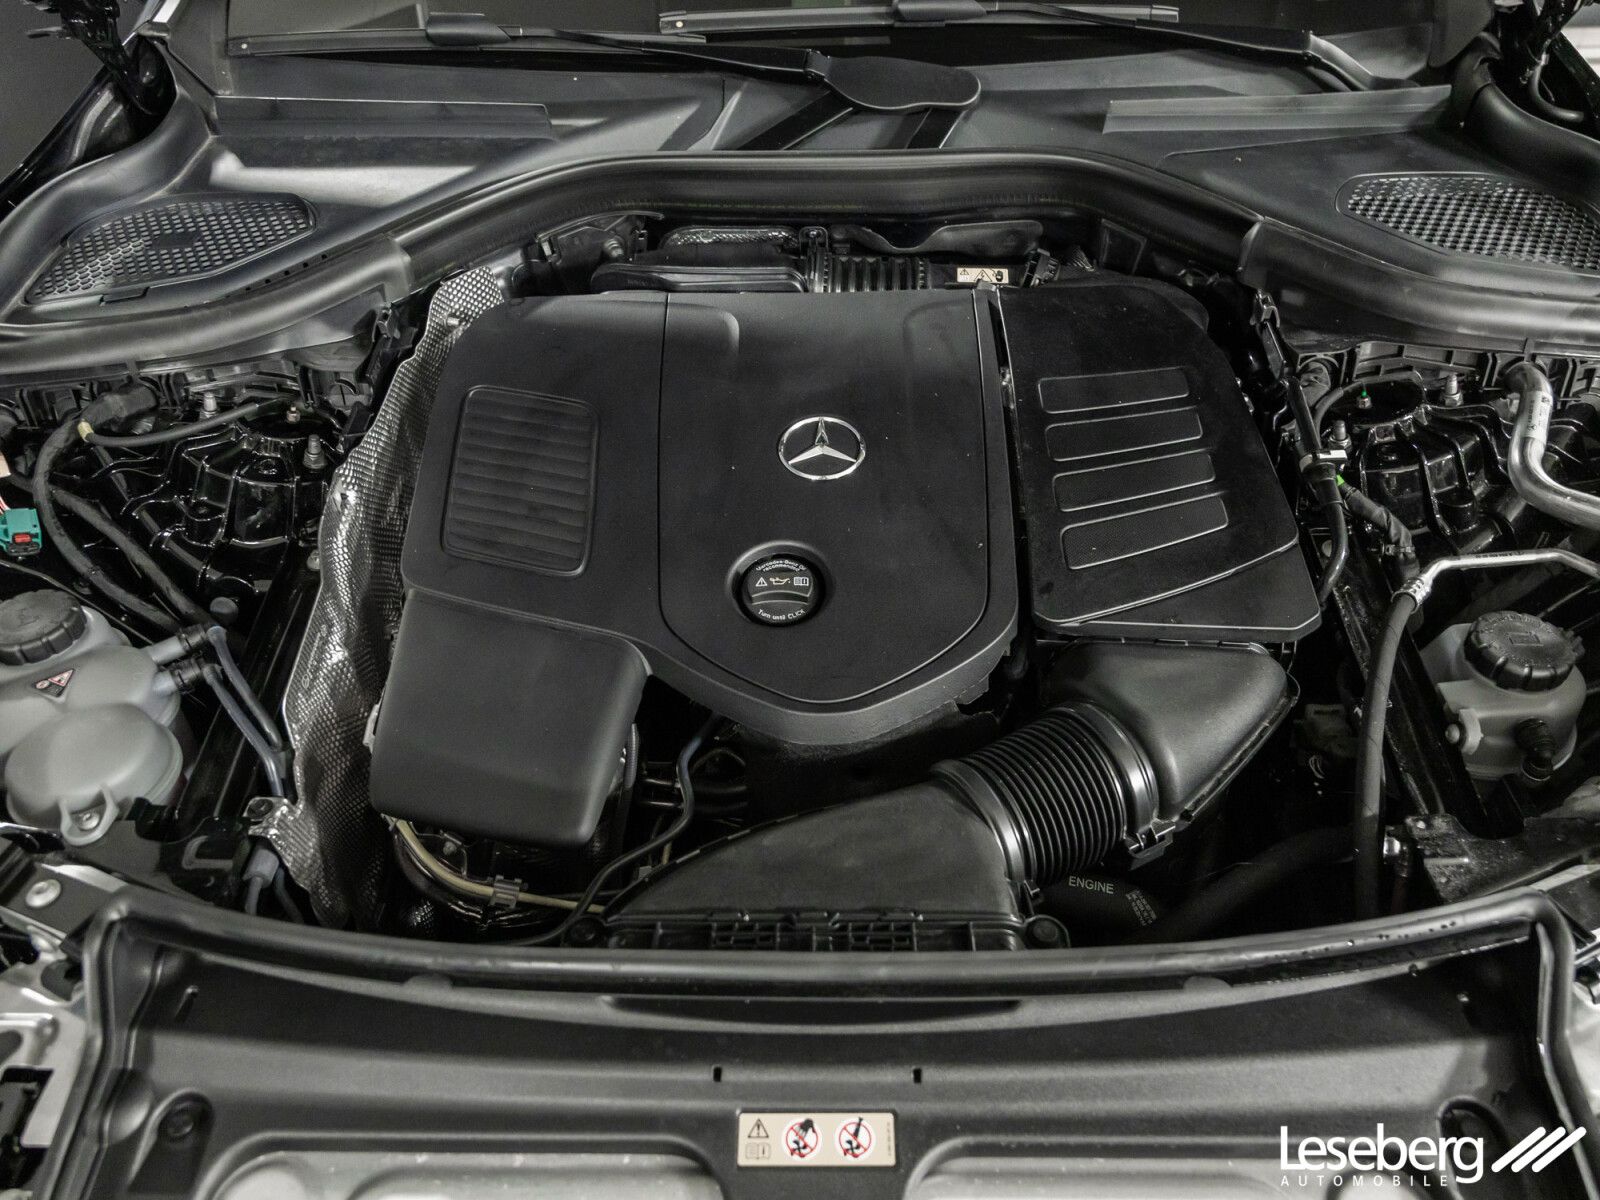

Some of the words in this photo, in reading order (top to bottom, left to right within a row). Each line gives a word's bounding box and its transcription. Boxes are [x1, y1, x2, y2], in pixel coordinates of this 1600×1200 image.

[758, 609, 771, 619] Turn
[787, 609, 806, 619] CLICK
[1068, 875, 1114, 895] ENGINE
